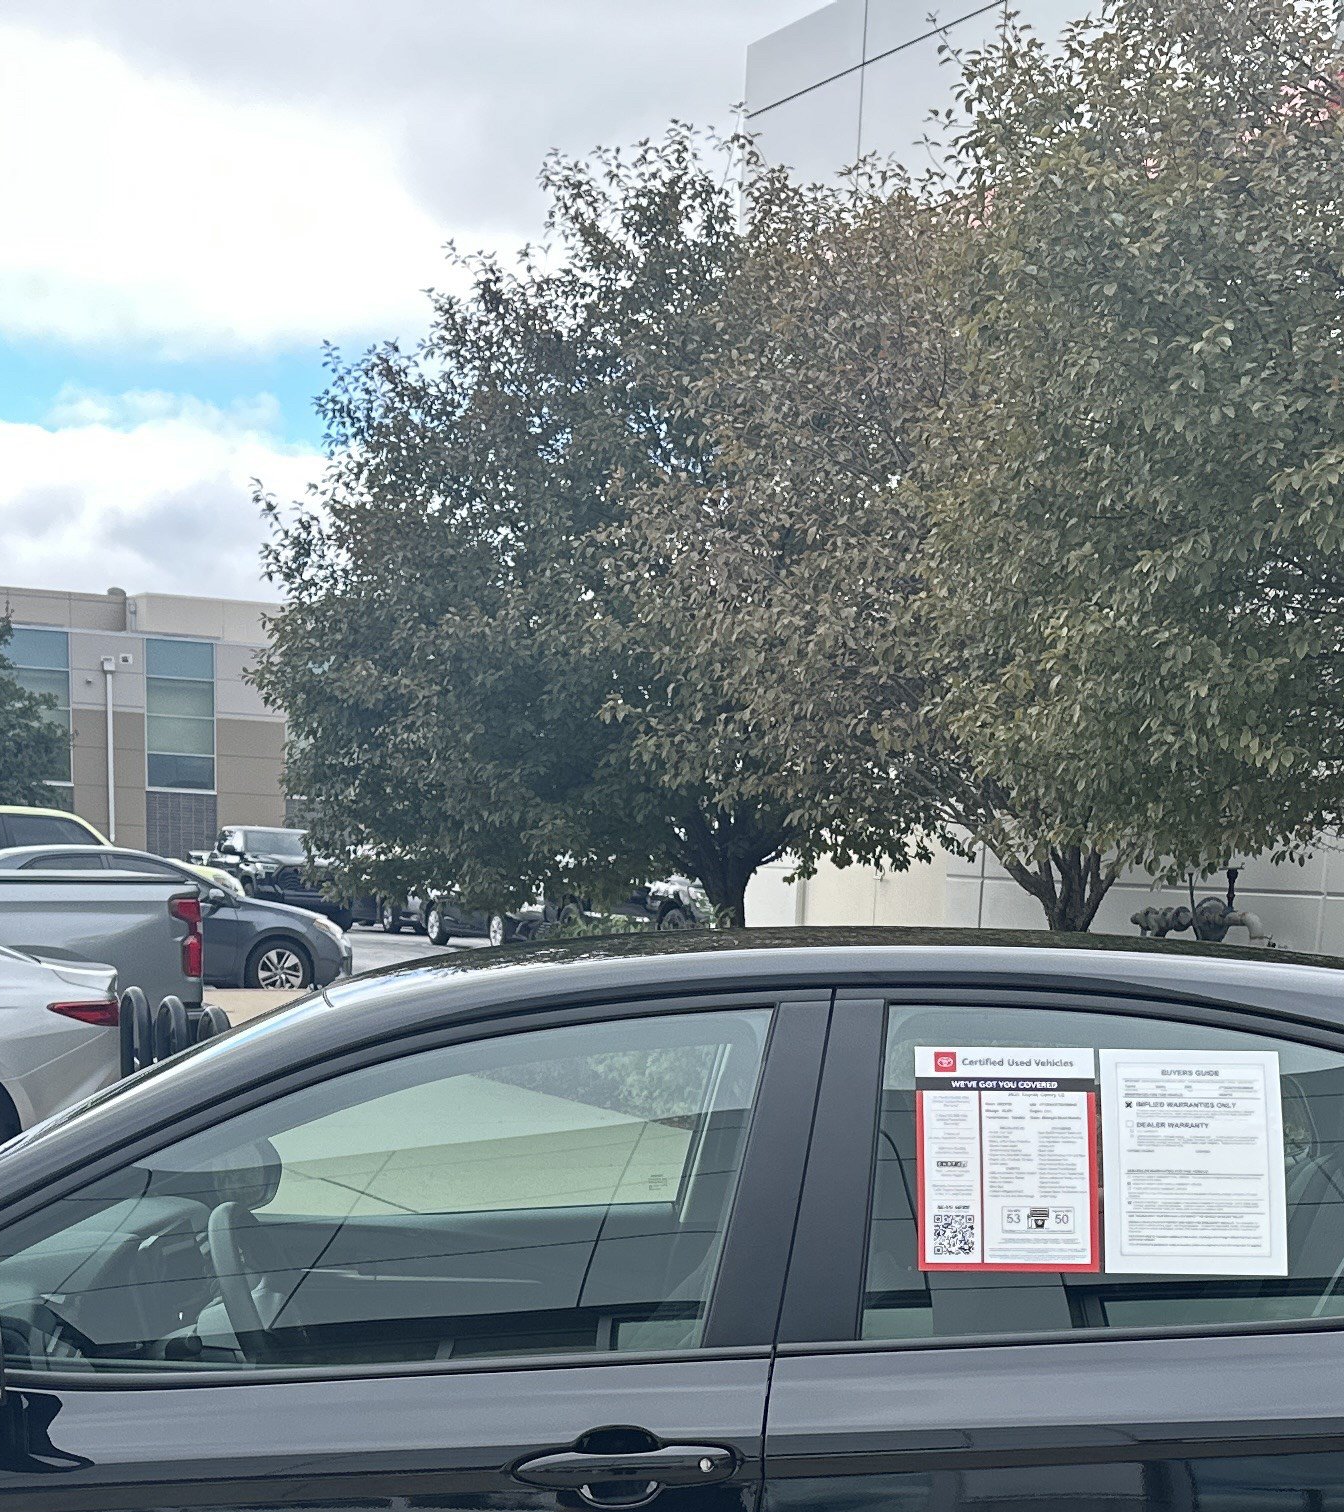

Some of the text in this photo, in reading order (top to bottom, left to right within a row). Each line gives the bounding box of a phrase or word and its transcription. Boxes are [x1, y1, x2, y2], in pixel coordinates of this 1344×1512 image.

[961, 1057, 1074, 1068] Certified Used Vehicles
[1161, 1069, 1193, 1077] BUYERS
[951, 1080, 1058, 1089] WE'VE GOT YOU COVERED
[1167, 1101, 1215, 1109] WARRANTIES
[1006, 1213, 1021, 1224] 53
[1055, 1214, 1069, 1225] 50
